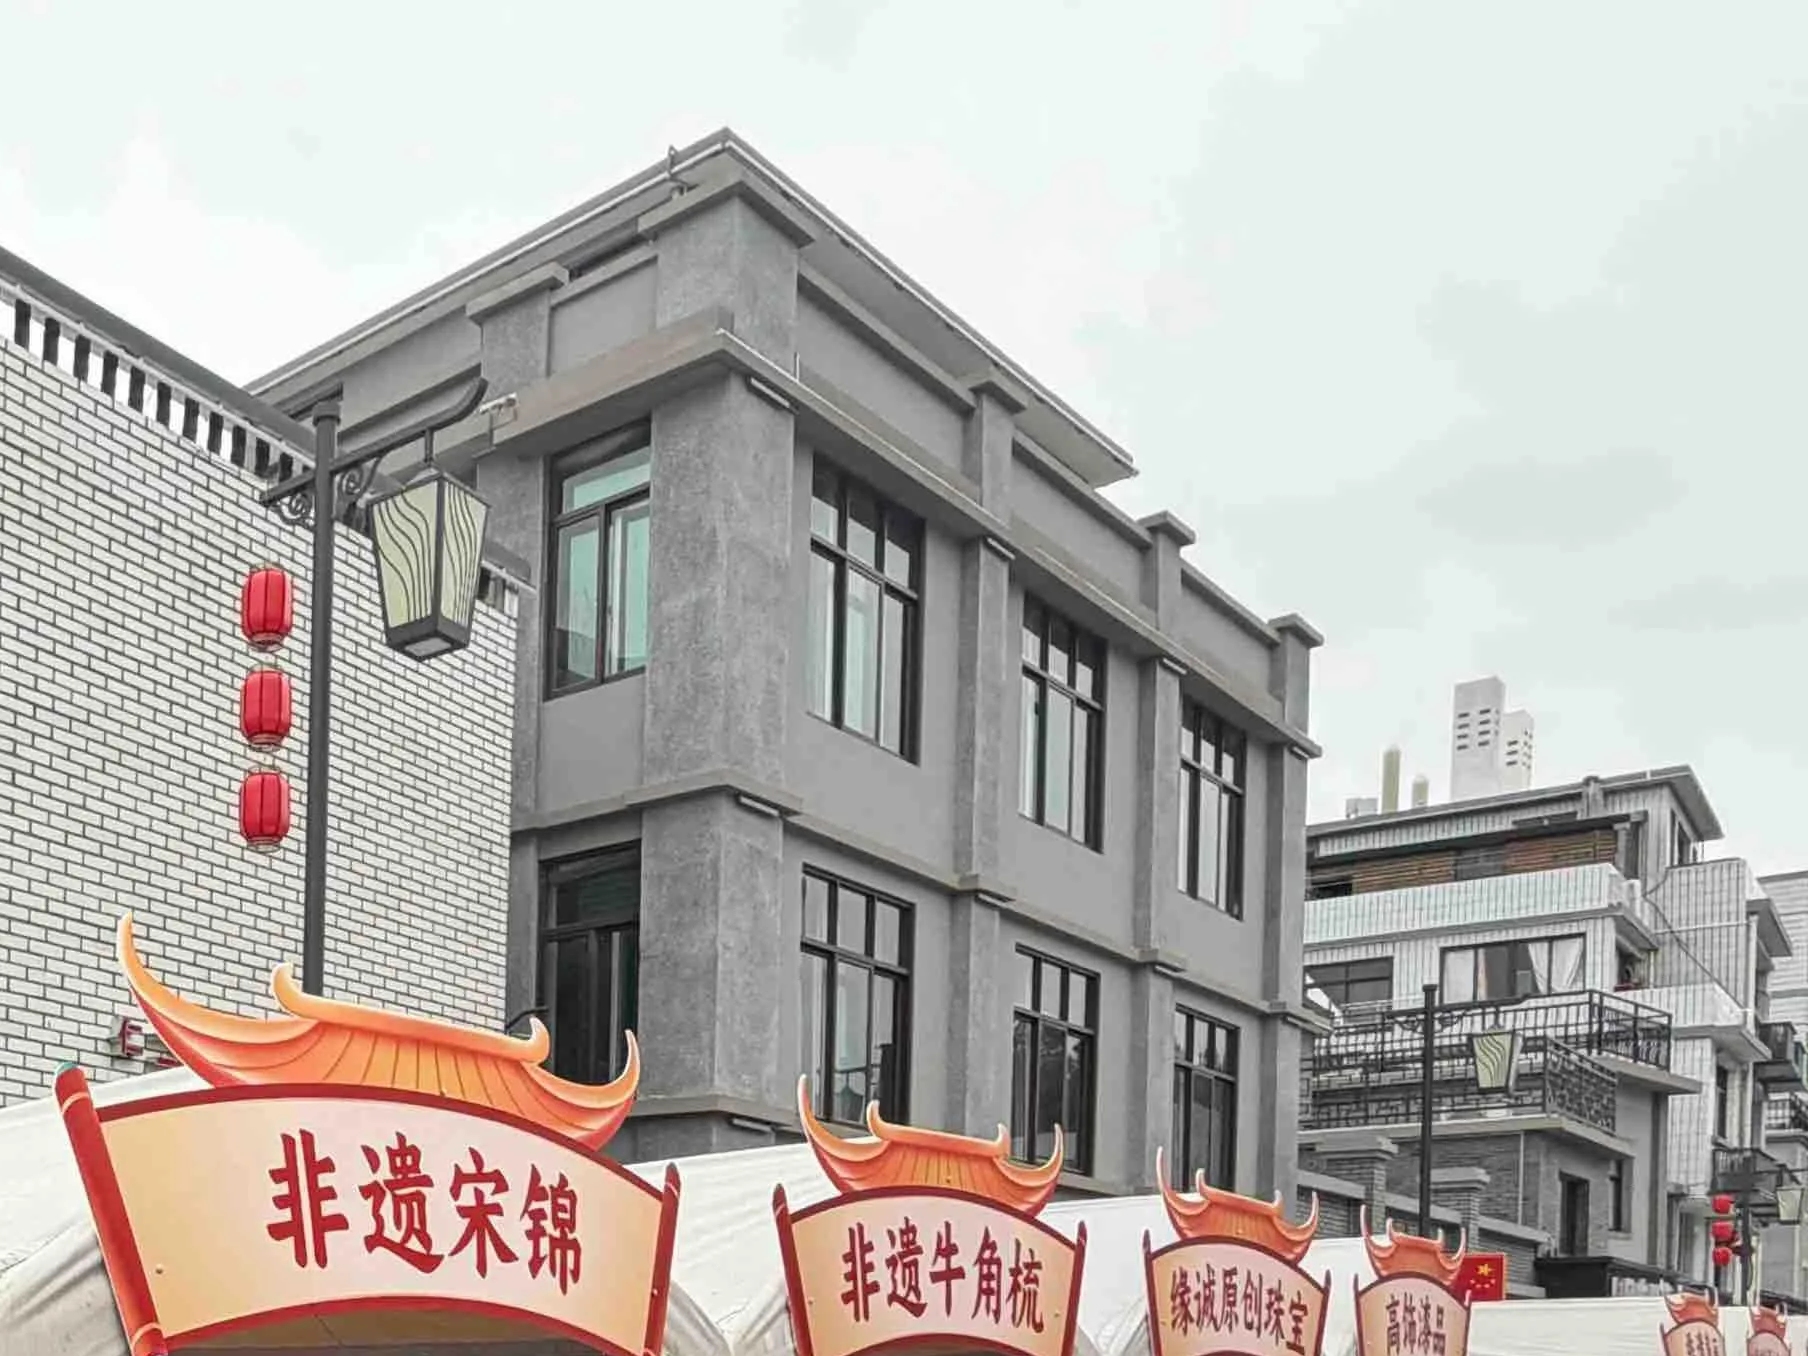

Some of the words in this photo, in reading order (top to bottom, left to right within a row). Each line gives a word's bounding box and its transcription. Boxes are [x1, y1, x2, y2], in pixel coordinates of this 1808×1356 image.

[266, 1128, 583, 1296] 非遗宋锦
[840, 1216, 1044, 1334] 非遗牛角梳
[1169, 1263, 1309, 1356] 缘诚原创珠宝
